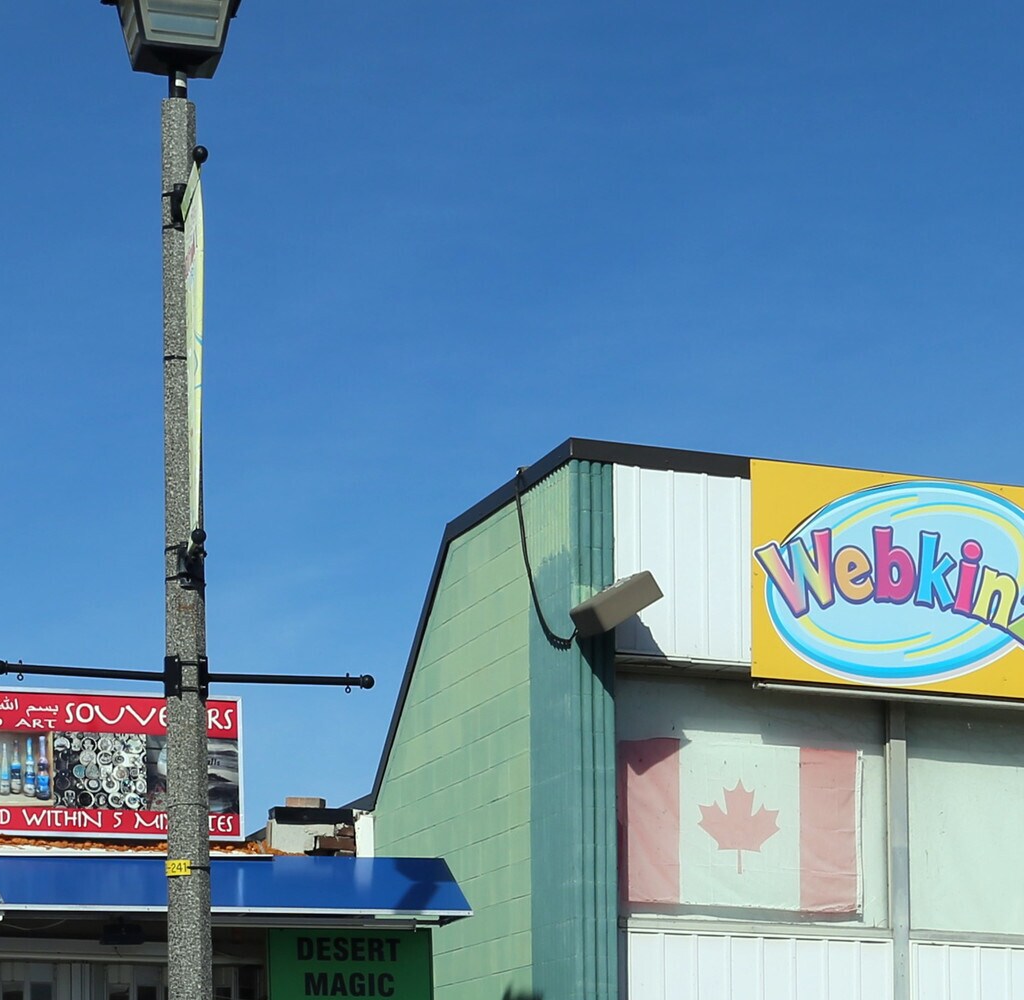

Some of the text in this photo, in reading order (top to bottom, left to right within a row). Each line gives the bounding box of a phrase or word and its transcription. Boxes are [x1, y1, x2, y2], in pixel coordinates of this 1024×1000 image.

[25, 701, 60, 717] بسم
[65, 702, 234, 730] SOUVERS
[14, 718, 58, 729] ART
[22, 808, 102, 828] WITHIN
[113, 812, 123, 829] 5
[134, 813, 234, 832] MITES
[296, 936, 401, 962] DESERT
[304, 972, 395, 998] MAGIC
